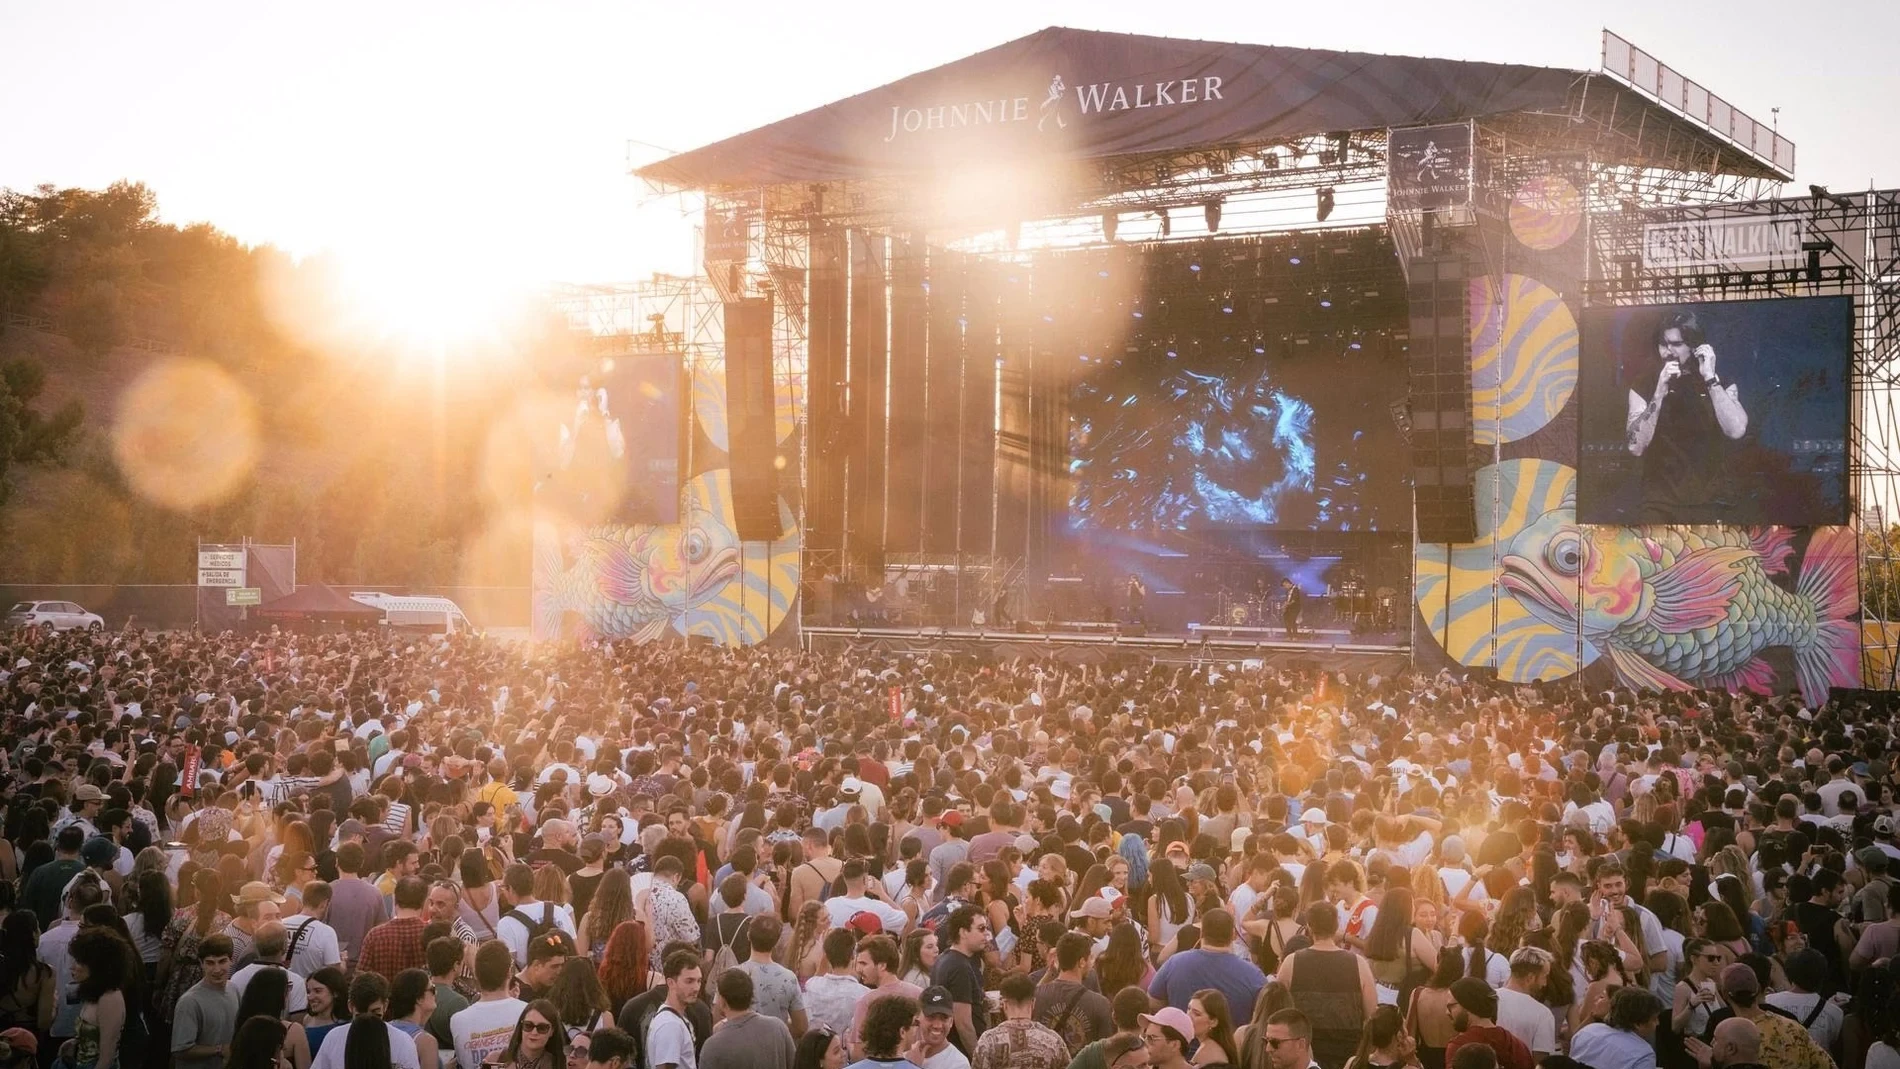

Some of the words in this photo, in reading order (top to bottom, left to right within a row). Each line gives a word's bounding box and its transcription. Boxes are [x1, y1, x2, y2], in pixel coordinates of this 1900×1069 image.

[885, 97, 1029, 142] JOHNNIE
[1076, 75, 1224, 114] WALKER
[1393, 187, 1429, 197] JOHNNIE
[1431, 184, 1466, 194] WALKER
[1704, 222, 1797, 258] WALKING
